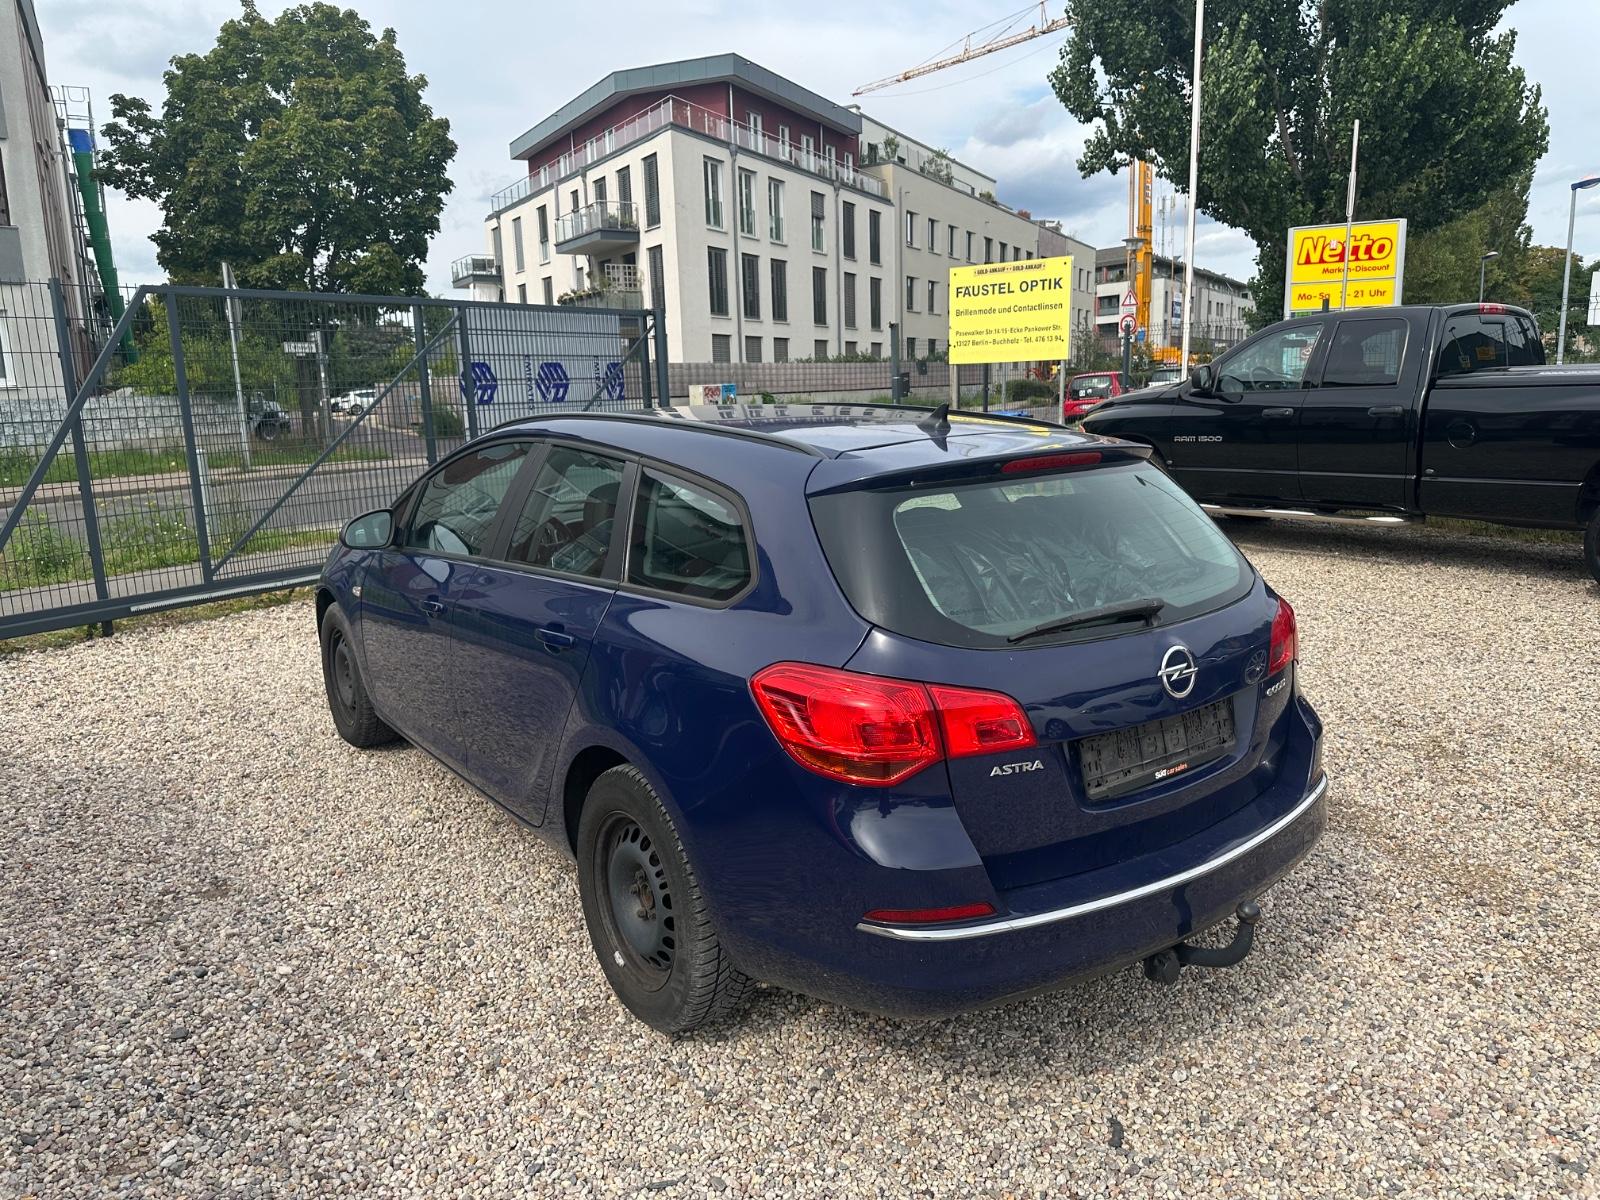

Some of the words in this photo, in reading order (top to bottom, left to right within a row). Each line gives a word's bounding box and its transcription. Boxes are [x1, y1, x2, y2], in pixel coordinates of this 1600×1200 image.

[1297, 233, 1393, 265] Netto
[955, 282, 1015, 298] FÄUSTEL
[1019, 277, 1063, 293] OPTIK
[1353, 290, 1364, 298] 21
[1369, 287, 1387, 298] Uhr
[955, 307, 997, 317] Brillenmode
[998, 305, 1012, 314] und
[1013, 302, 1063, 313] Contactlinsen
[1024, 325, 1051, 333] Pankower
[989, 759, 1045, 777] ASTRA
